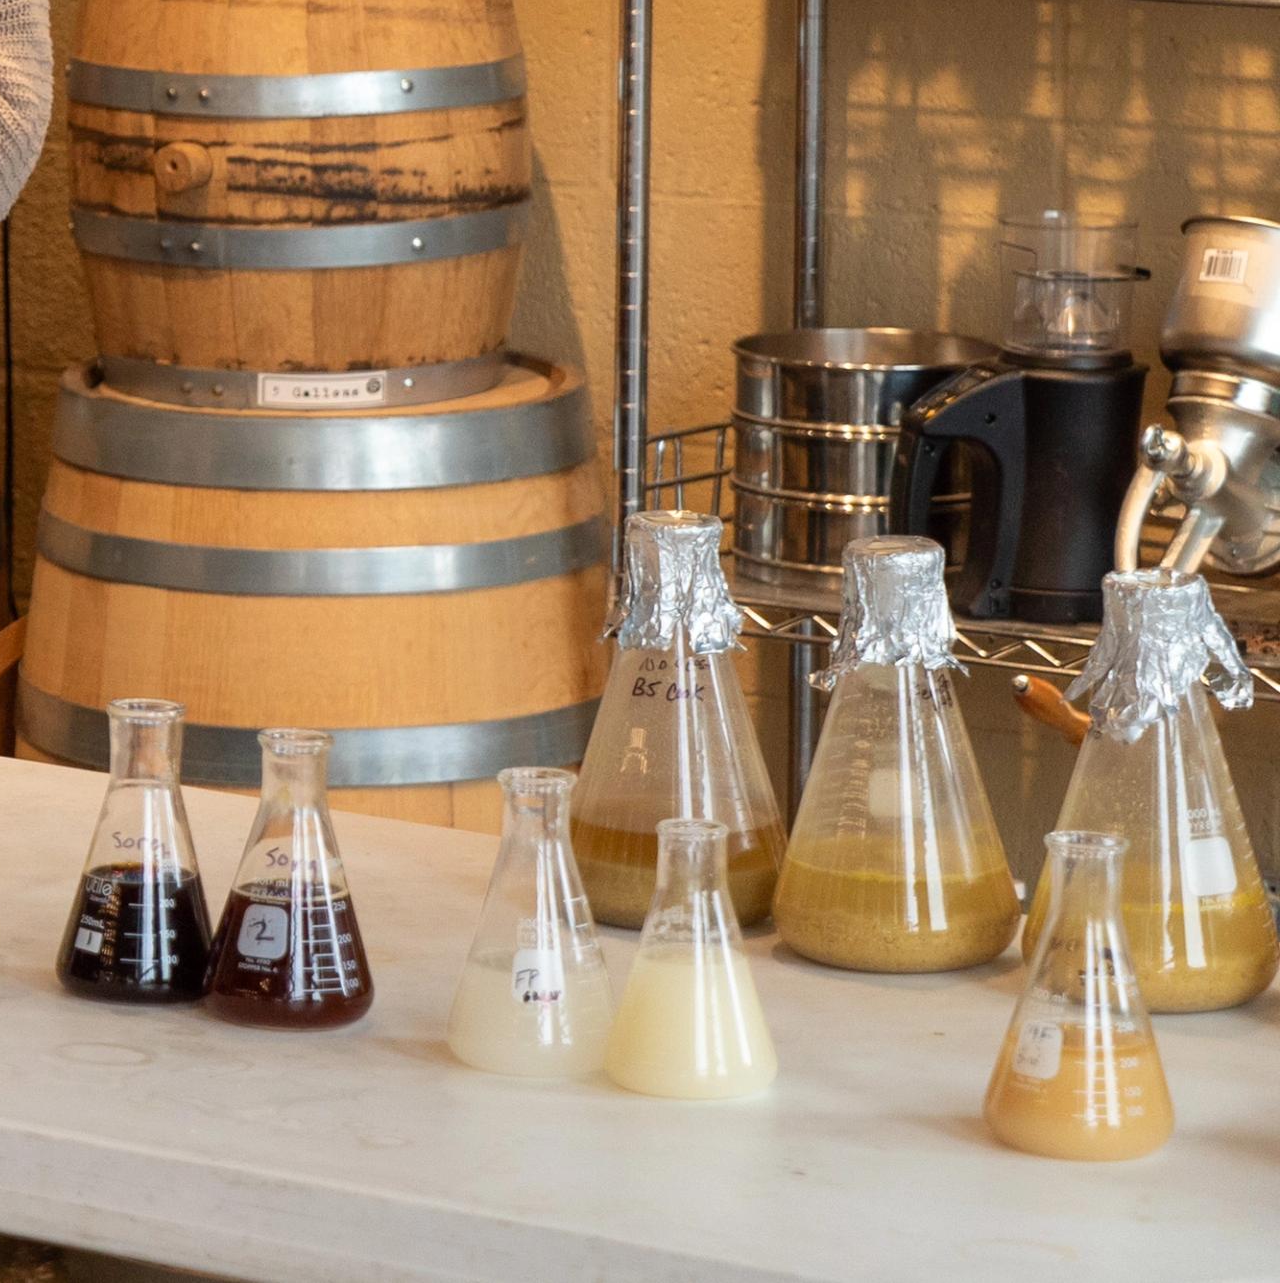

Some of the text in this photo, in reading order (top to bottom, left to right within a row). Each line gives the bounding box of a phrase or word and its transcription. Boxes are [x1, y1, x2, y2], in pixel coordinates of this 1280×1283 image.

[291, 386, 360, 399] Gallons
[248, 918, 275, 943] 2
[337, 933, 353, 944] 200
